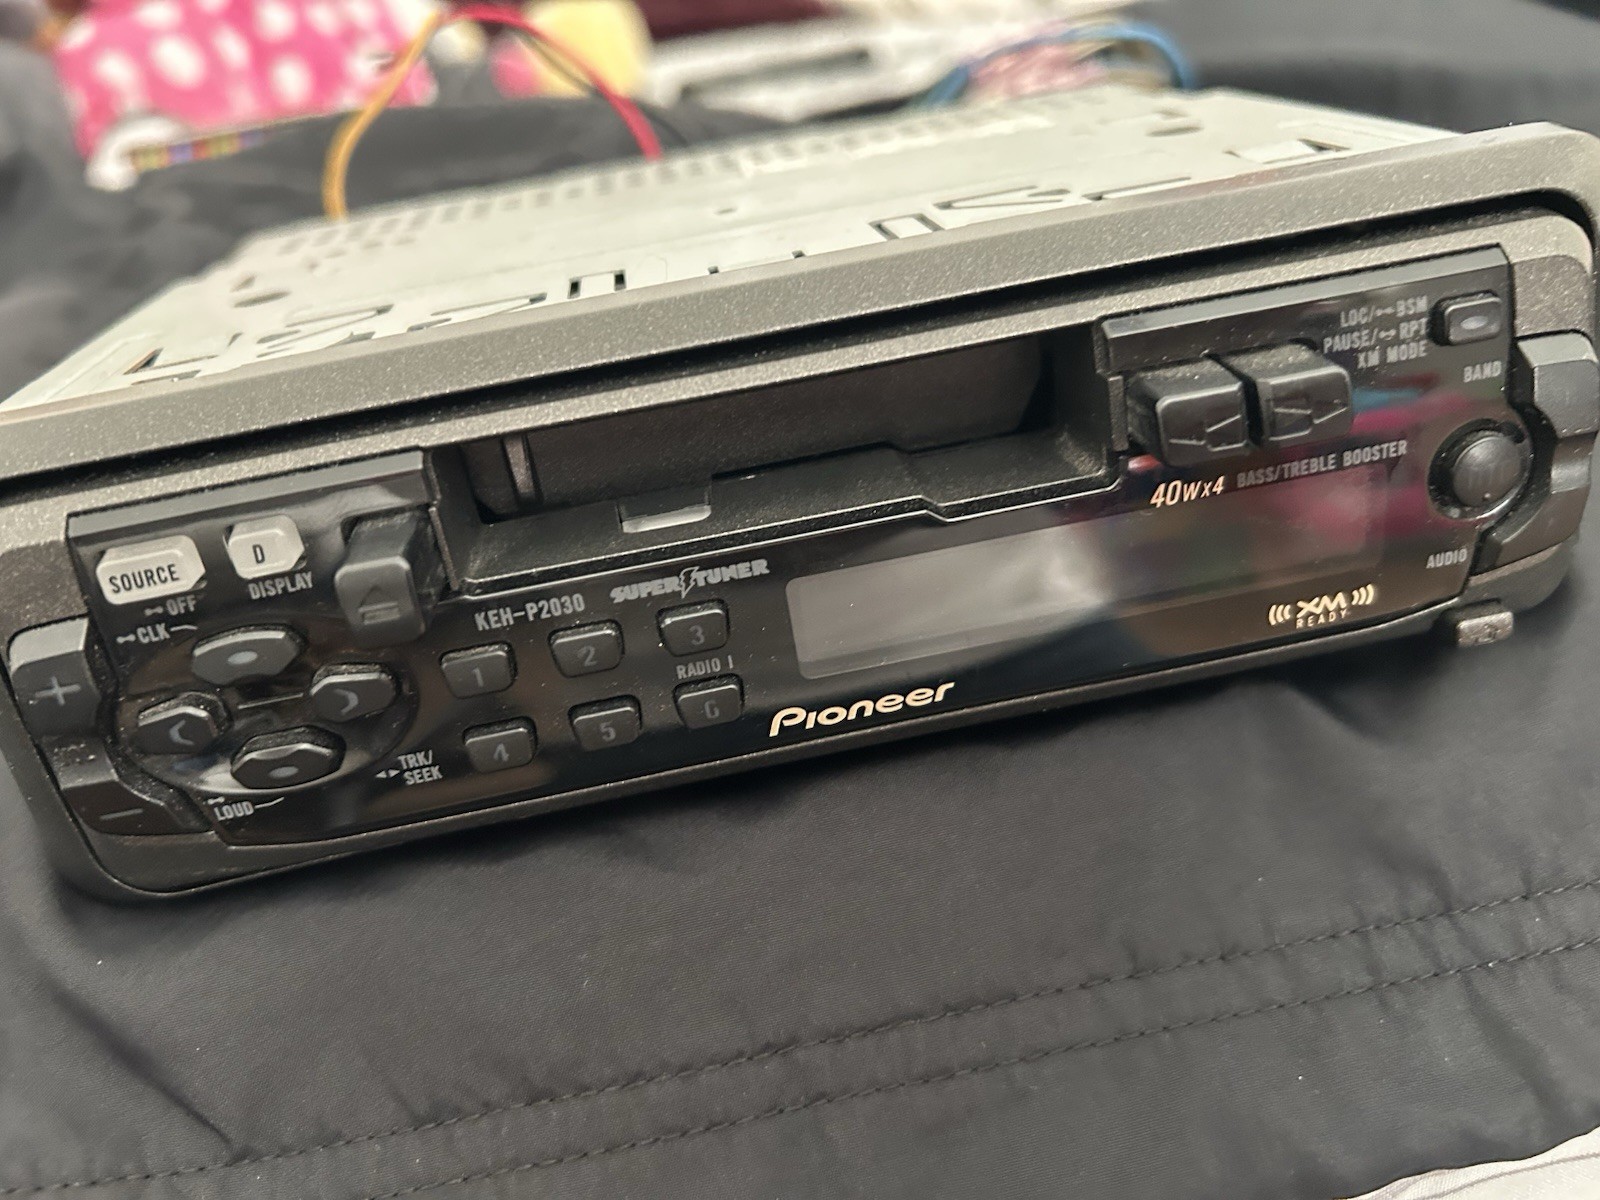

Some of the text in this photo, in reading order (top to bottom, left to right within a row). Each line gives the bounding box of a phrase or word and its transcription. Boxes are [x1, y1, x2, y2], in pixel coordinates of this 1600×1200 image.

[1396, 295, 1428, 315] BSM
[1323, 317, 1428, 354] PAUSE/ RPT
[1357, 341, 1428, 369] XM MODE
[1463, 361, 1502, 383] BAND
[1237, 440, 1408, 488] BASS/TREBLE BOOSTER
[253, 543, 265, 564] D
[1425, 548, 1467, 569] AUDIO
[108, 563, 180, 594] SOURCE
[248, 571, 314, 600] DISPLAY
[167, 596, 196, 616] OFF
[475, 594, 586, 631] KEH-P2030
[1296, 592, 1348, 617] XM
[1295, 609, 1349, 629] READY
[137, 624, 170, 644] CLK
[690, 626, 705, 645] 3
[583, 646, 597, 667] 2
[473, 668, 483, 688] 1
[676, 660, 721, 679] RADIO
[769, 682, 955, 737] Pioneer
[600, 721, 615, 741] 5
[400, 750, 433, 772] TRK/
[493, 742, 508, 763] 4
[403, 765, 442, 786] SEEK
[214, 801, 254, 822] LOUD
